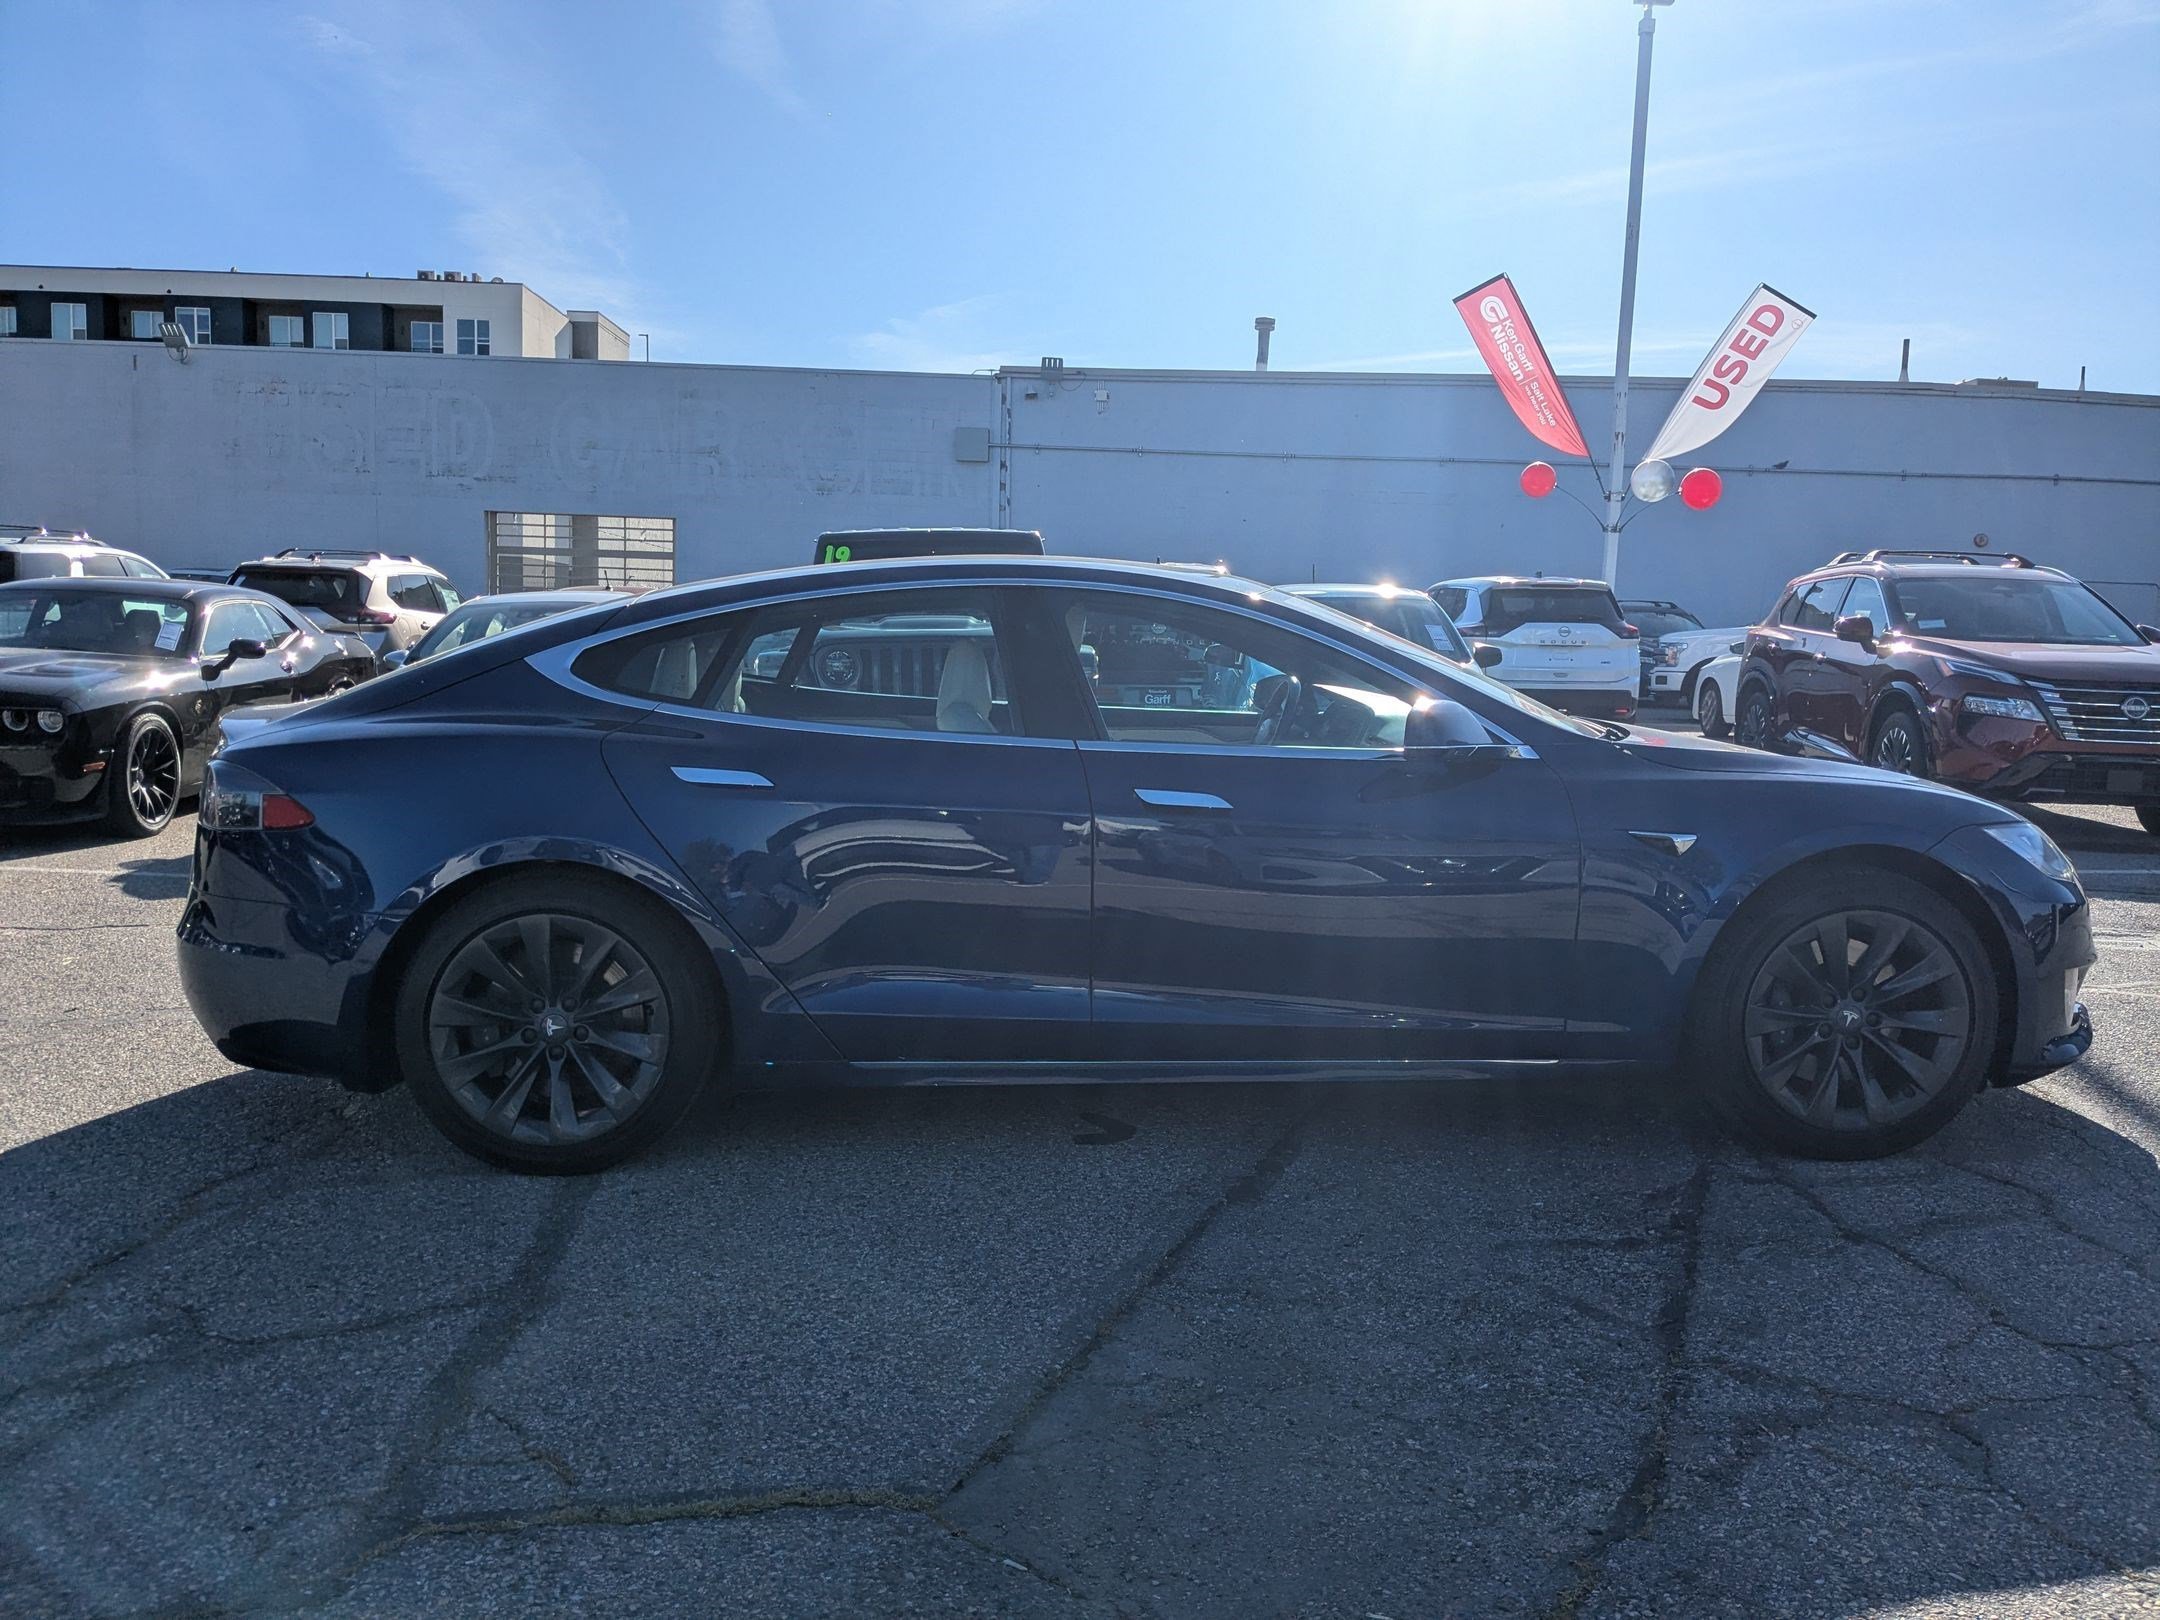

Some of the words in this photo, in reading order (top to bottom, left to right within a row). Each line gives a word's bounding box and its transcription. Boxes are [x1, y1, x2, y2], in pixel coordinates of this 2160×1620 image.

[1490, 325, 1524, 382] Nissan
[1503, 318, 1518, 344] Ken
[1514, 343, 1535, 373] Garff
[1691, 303, 1786, 411] USED
[1530, 381, 1544, 403] Salt
[1540, 401, 1556, 427] Lake
[823, 544, 851, 564] 19
[1144, 694, 1171, 704] Garff
